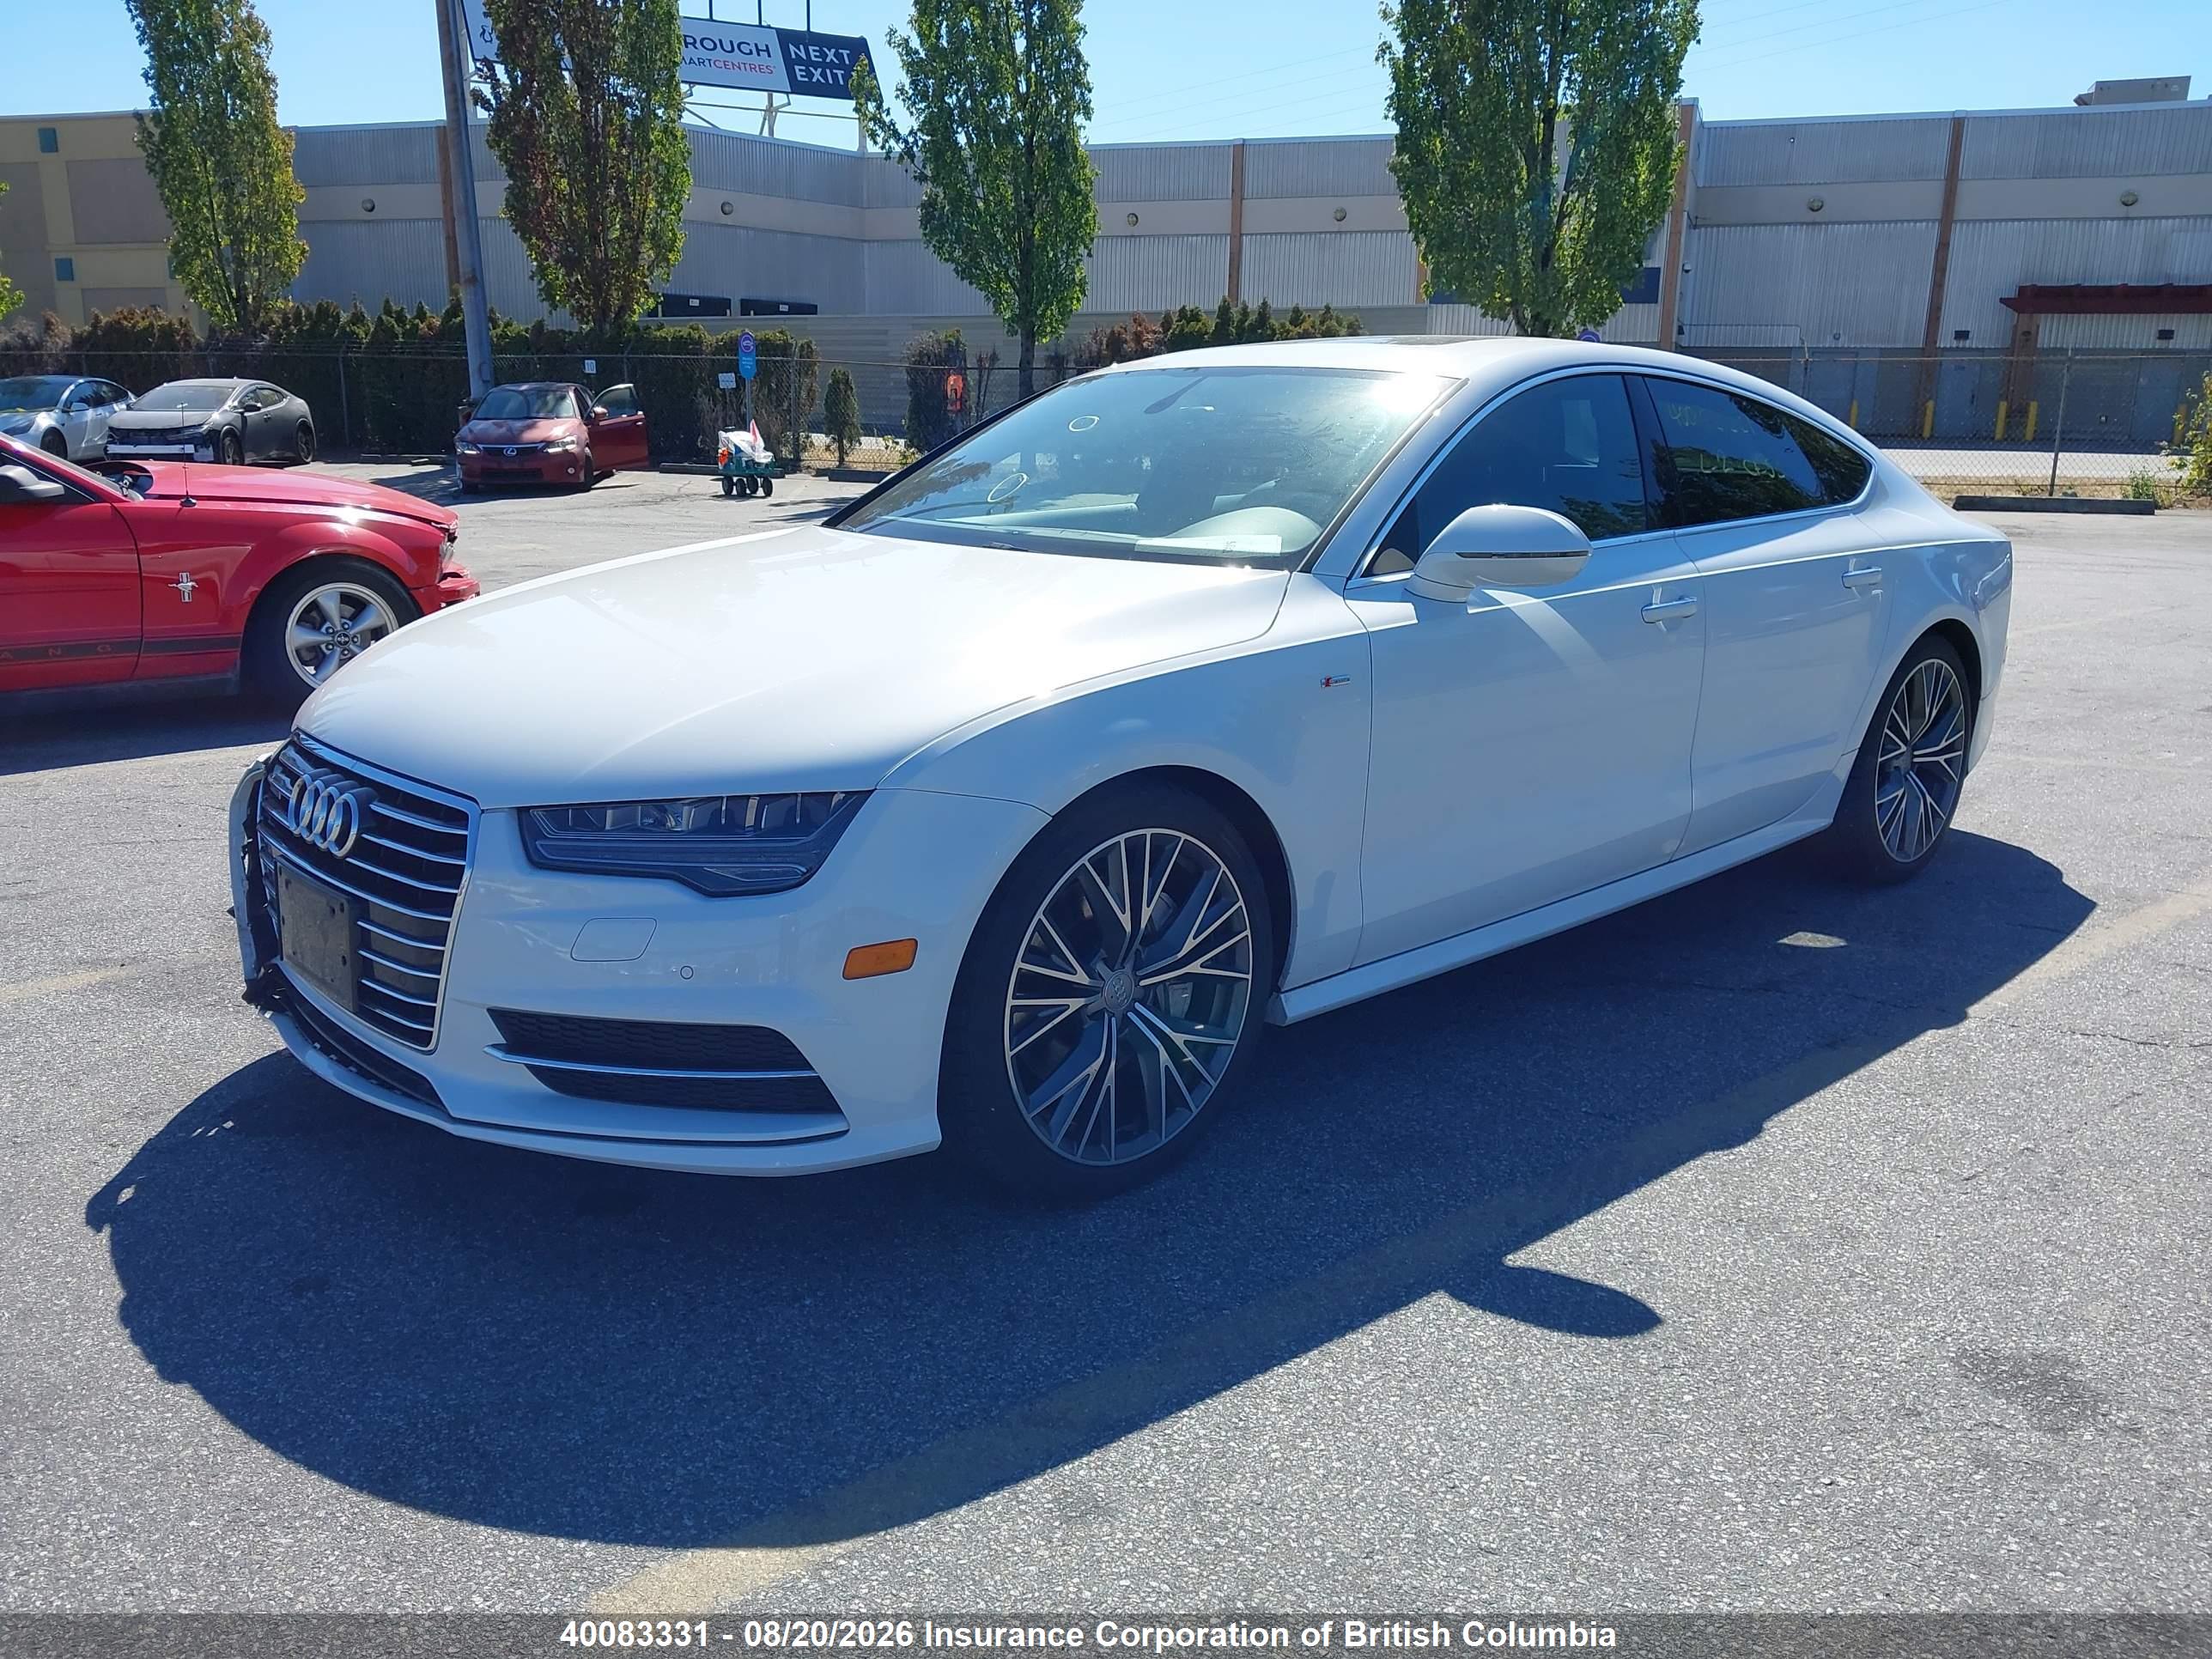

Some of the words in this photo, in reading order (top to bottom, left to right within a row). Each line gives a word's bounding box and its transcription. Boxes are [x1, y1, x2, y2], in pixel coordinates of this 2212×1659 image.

[684, 34, 771, 58] ROUGH
[788, 43, 850, 64] NEXT
[793, 64, 845, 85] EXIT
